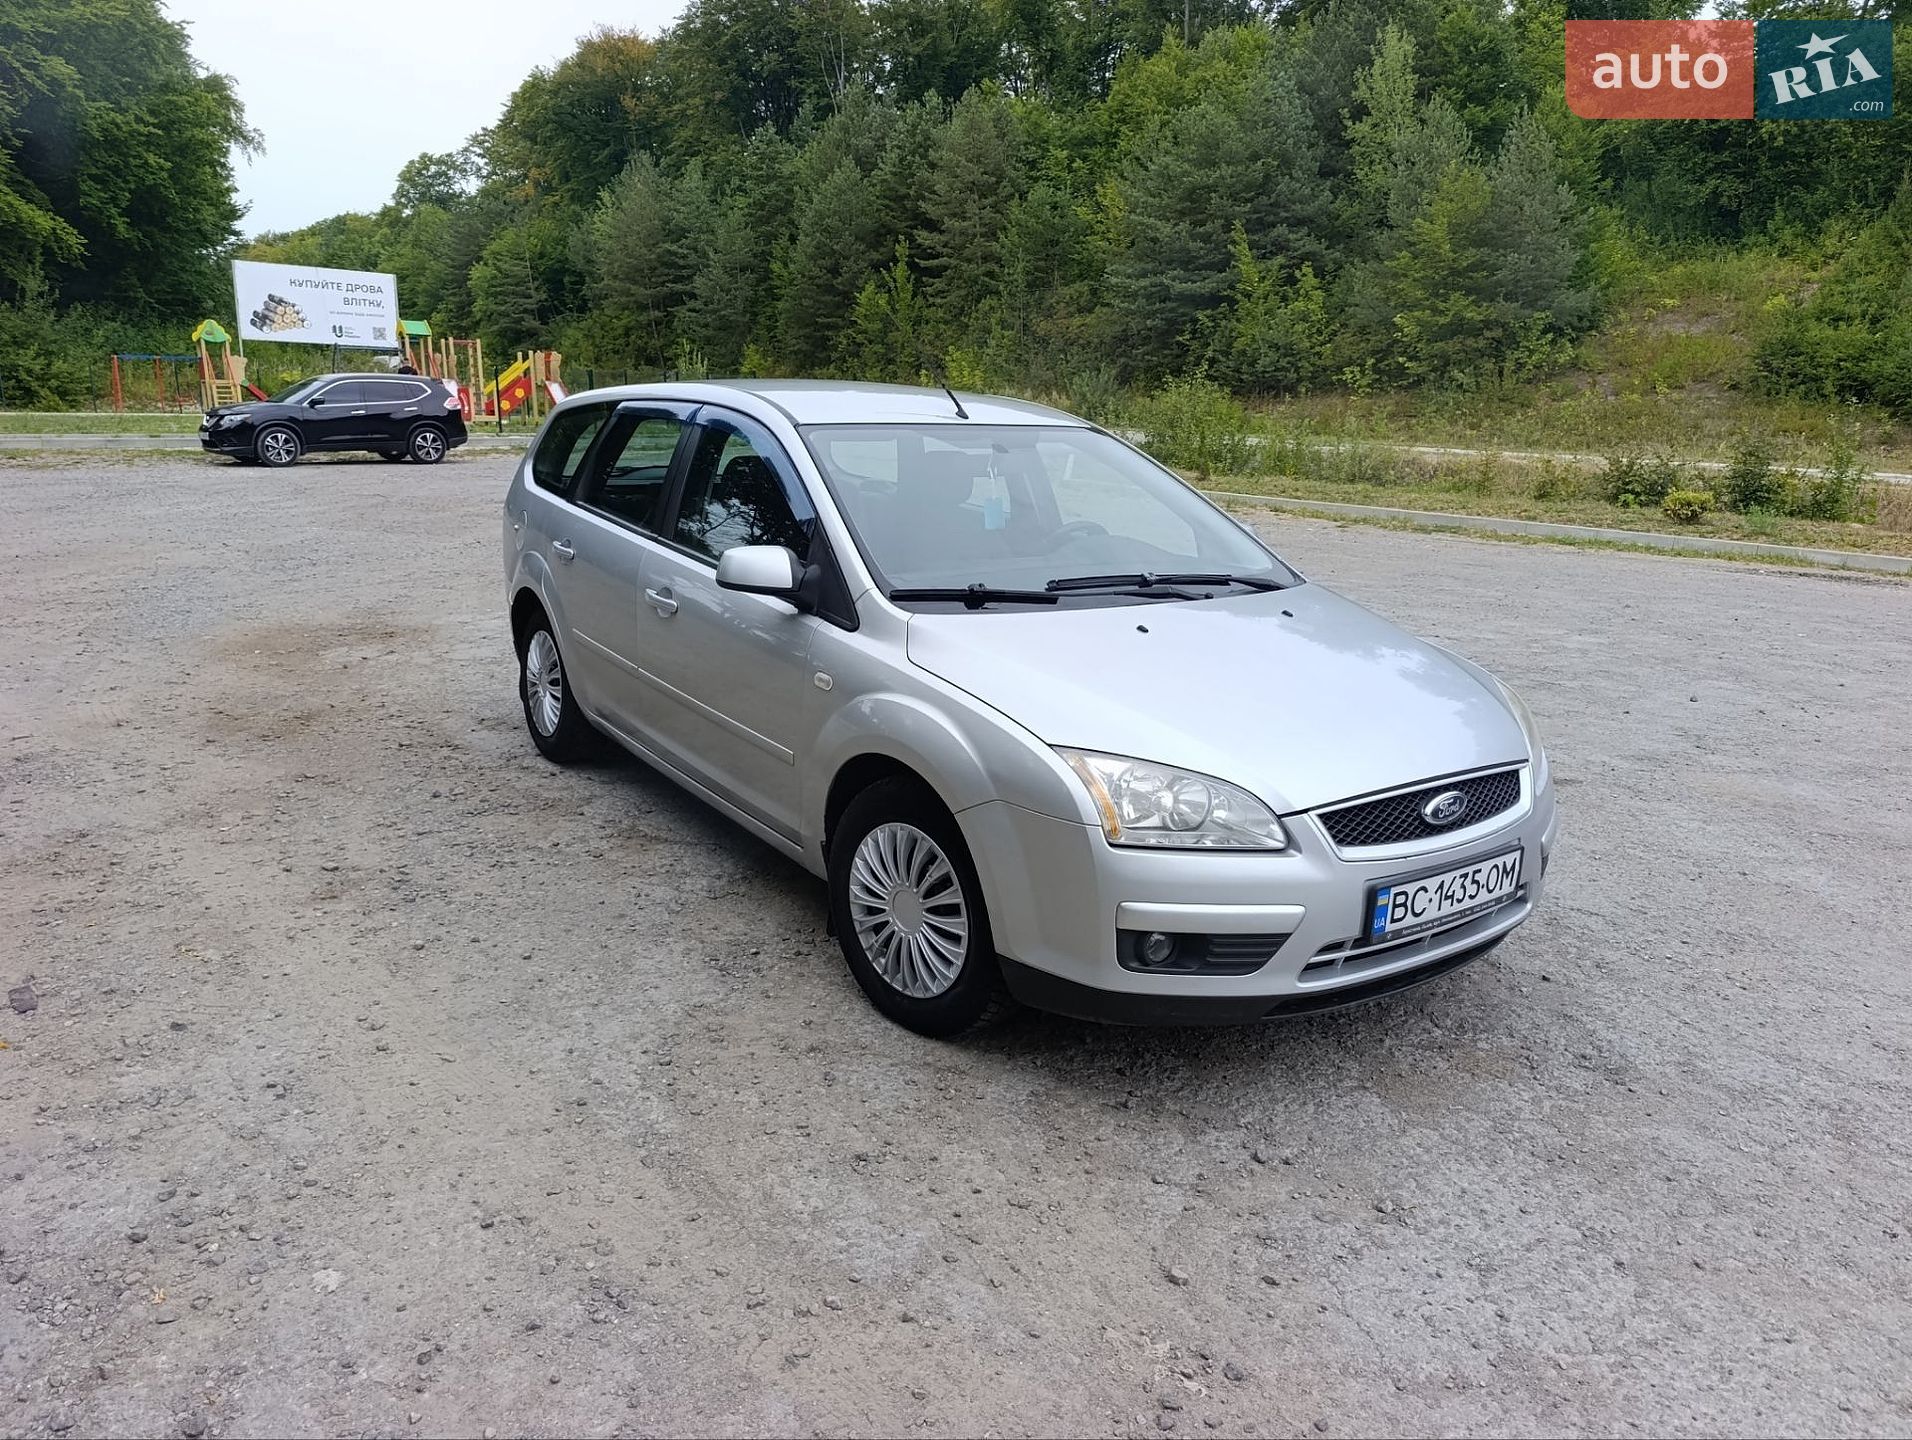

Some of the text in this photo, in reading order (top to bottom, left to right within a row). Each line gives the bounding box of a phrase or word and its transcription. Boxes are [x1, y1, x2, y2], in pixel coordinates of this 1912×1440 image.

[289, 278, 383, 294] КУПУЙТЕ ДРОВА
[1439, 798, 1460, 818] Ford
[1373, 917, 1386, 929] UA
